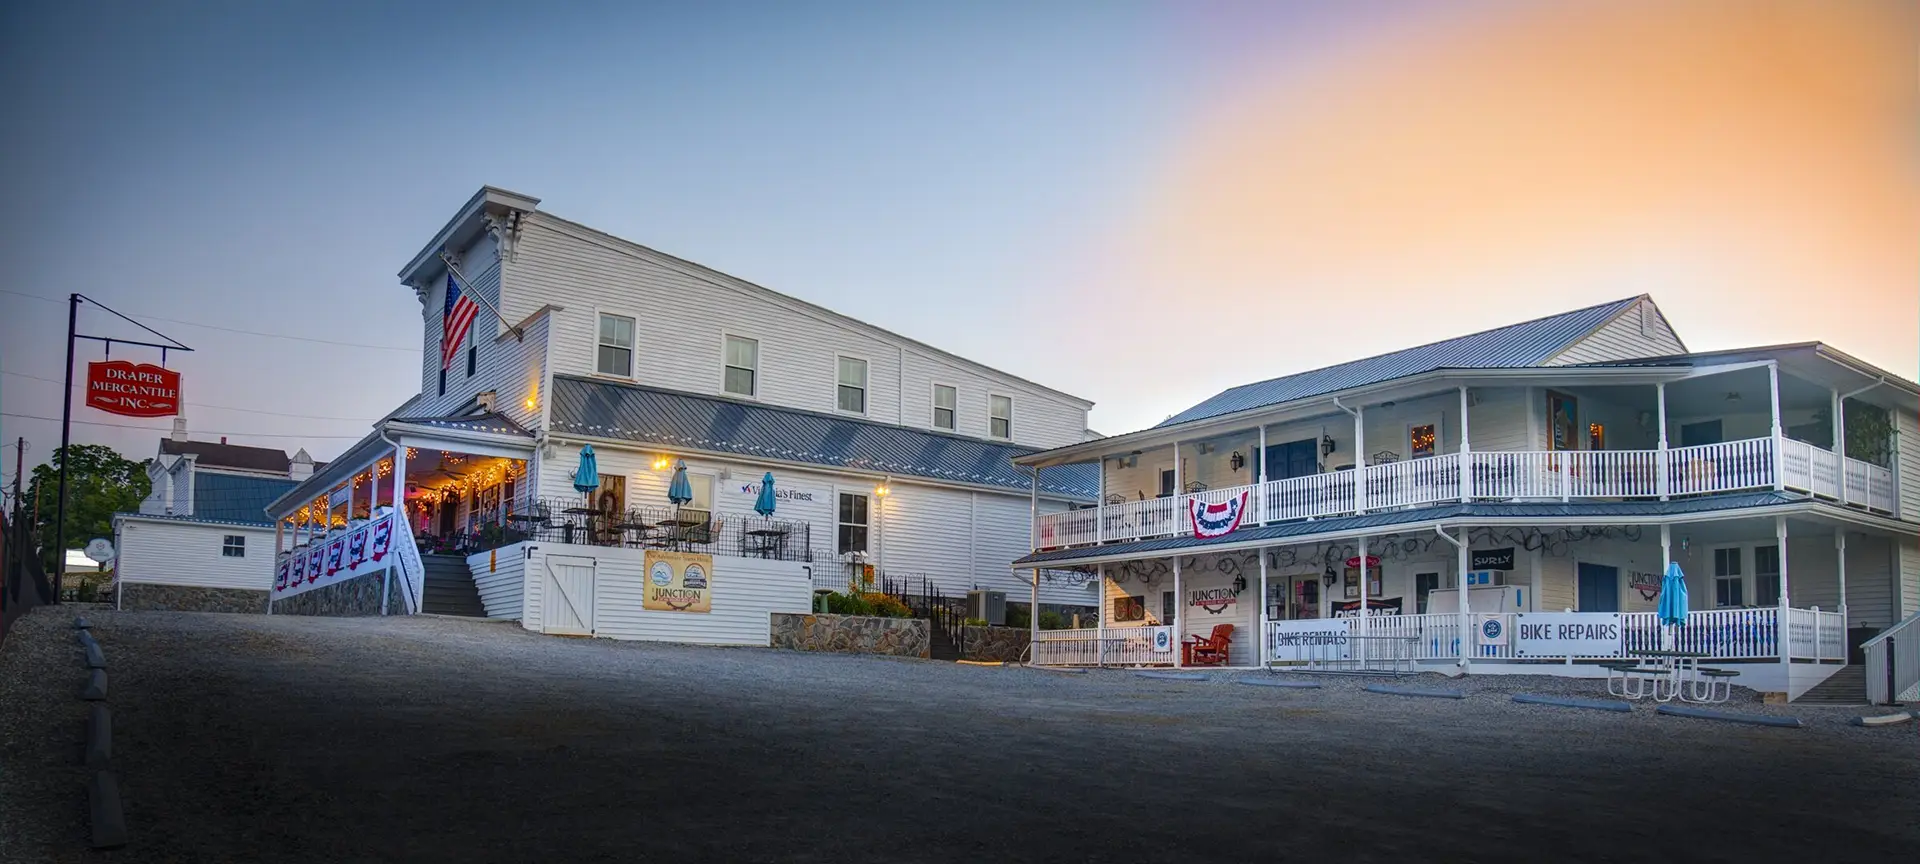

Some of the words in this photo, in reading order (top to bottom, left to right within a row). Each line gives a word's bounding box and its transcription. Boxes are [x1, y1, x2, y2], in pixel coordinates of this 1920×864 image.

[106, 368, 163, 384] DRAPER
[91, 380, 176, 399] MERCANTILE
[120, 396, 150, 409] INC.
[789, 489, 813, 501] Finest
[1474, 555, 1511, 566] SURLY
[652, 587, 701, 601] JUNCTION
[1189, 588, 1236, 606] JUNCTION
[1277, 632, 1300, 646] BIKE
[1302, 630, 1347, 646] RENTALS
[1520, 624, 1552, 640] BIKE
[1558, 624, 1617, 640] REPAIRS
